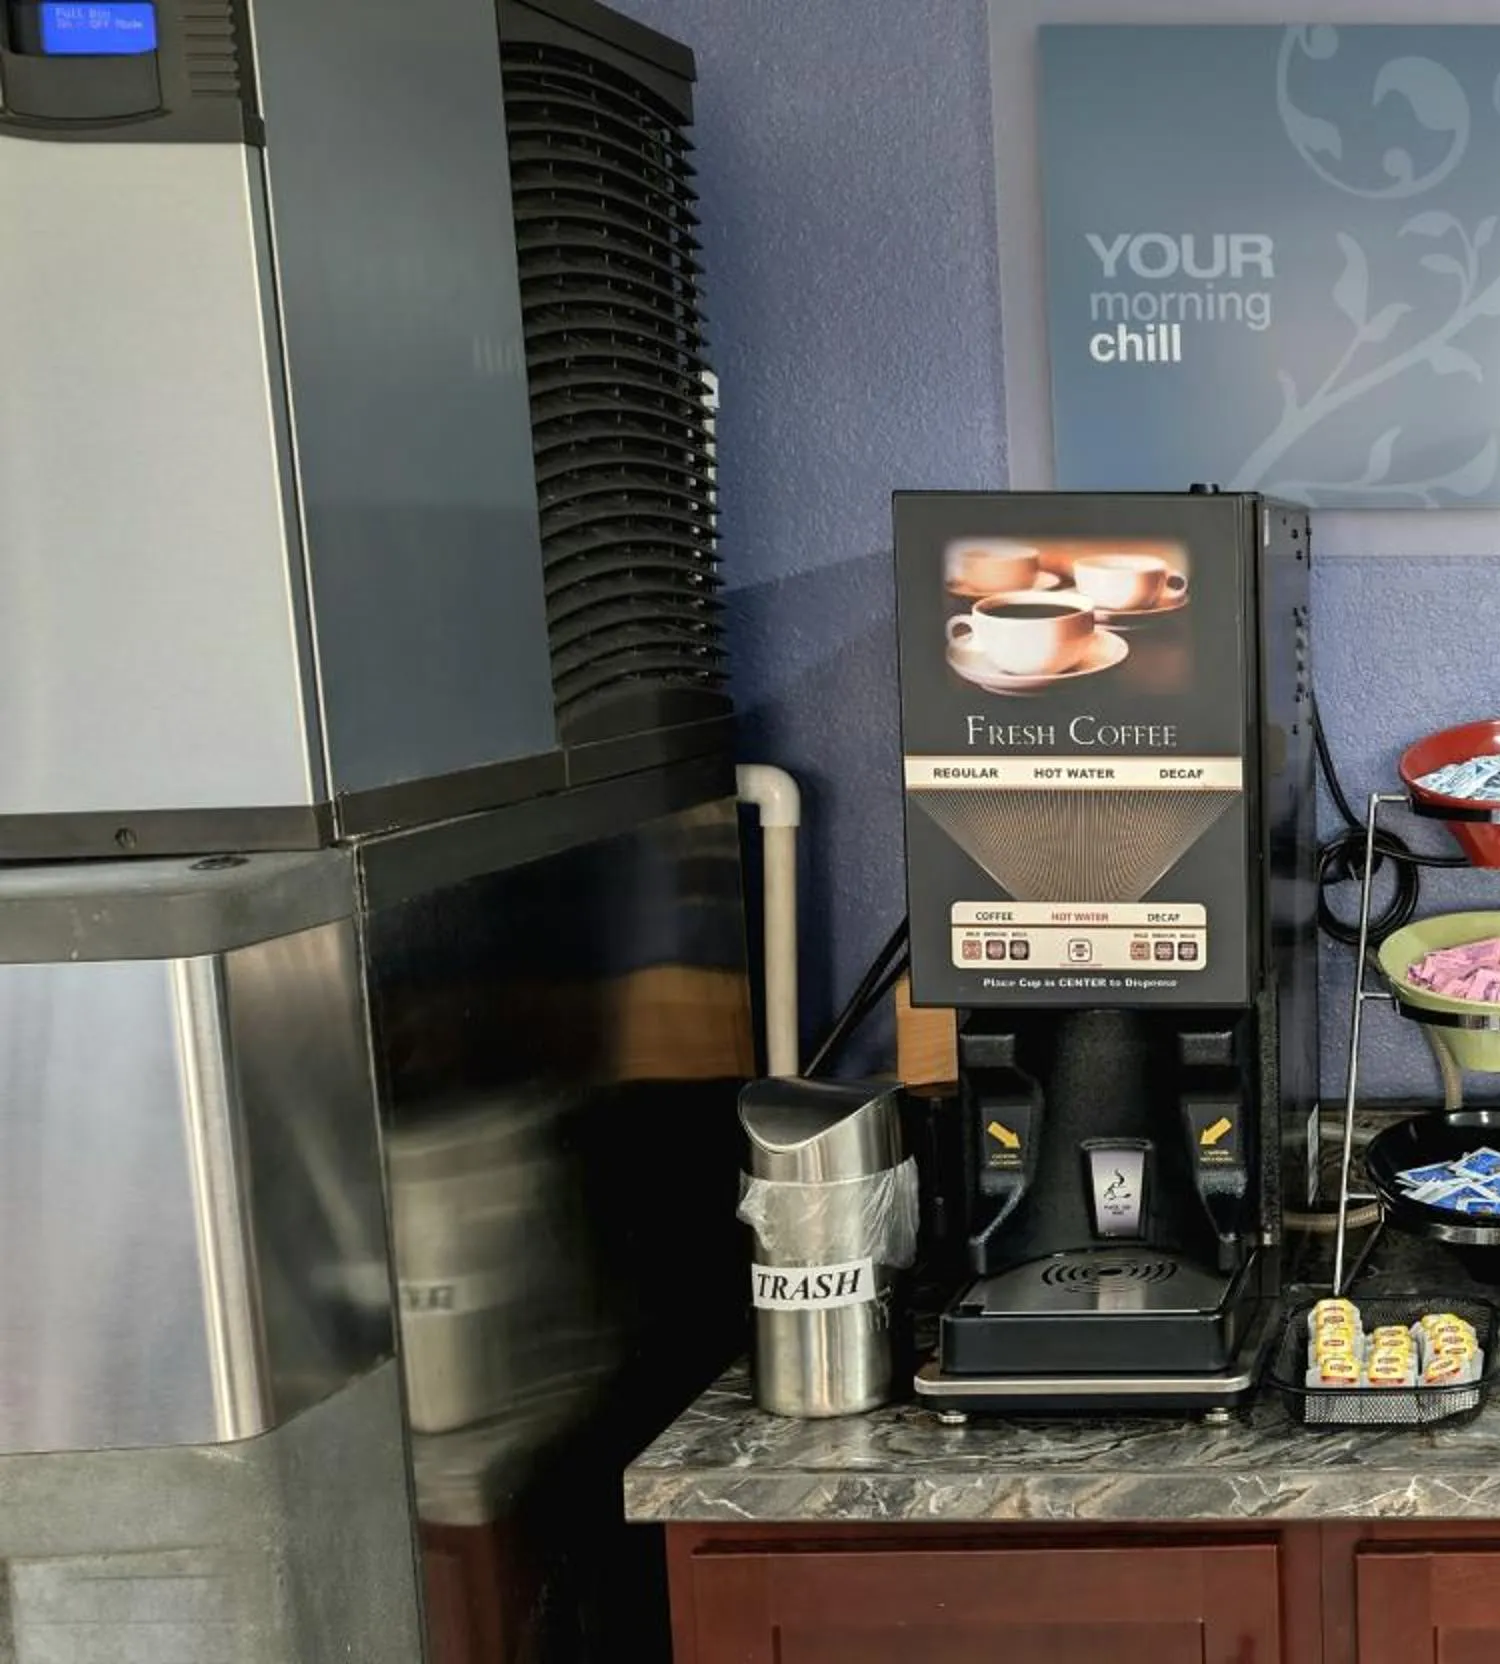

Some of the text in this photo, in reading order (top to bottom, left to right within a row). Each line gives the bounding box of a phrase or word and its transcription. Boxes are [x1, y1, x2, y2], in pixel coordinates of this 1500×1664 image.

[1086, 233, 1275, 279] YOUR
[1090, 283, 1271, 331] morning
[1089, 324, 1182, 362] chill
[967, 715, 1178, 748] FRESH COFFEE
[933, 768, 998, 779] REGULAR
[1034, 768, 1115, 780] HOT WATER
[1159, 769, 1205, 780] DECAF
[975, 911, 1014, 921] COFFEE
[1051, 912, 1109, 922] HOT WATER
[1147, 913, 1181, 922] DECAF
[1058, 978, 1107, 988] CENTER
[757, 1268, 861, 1300] TRASH
